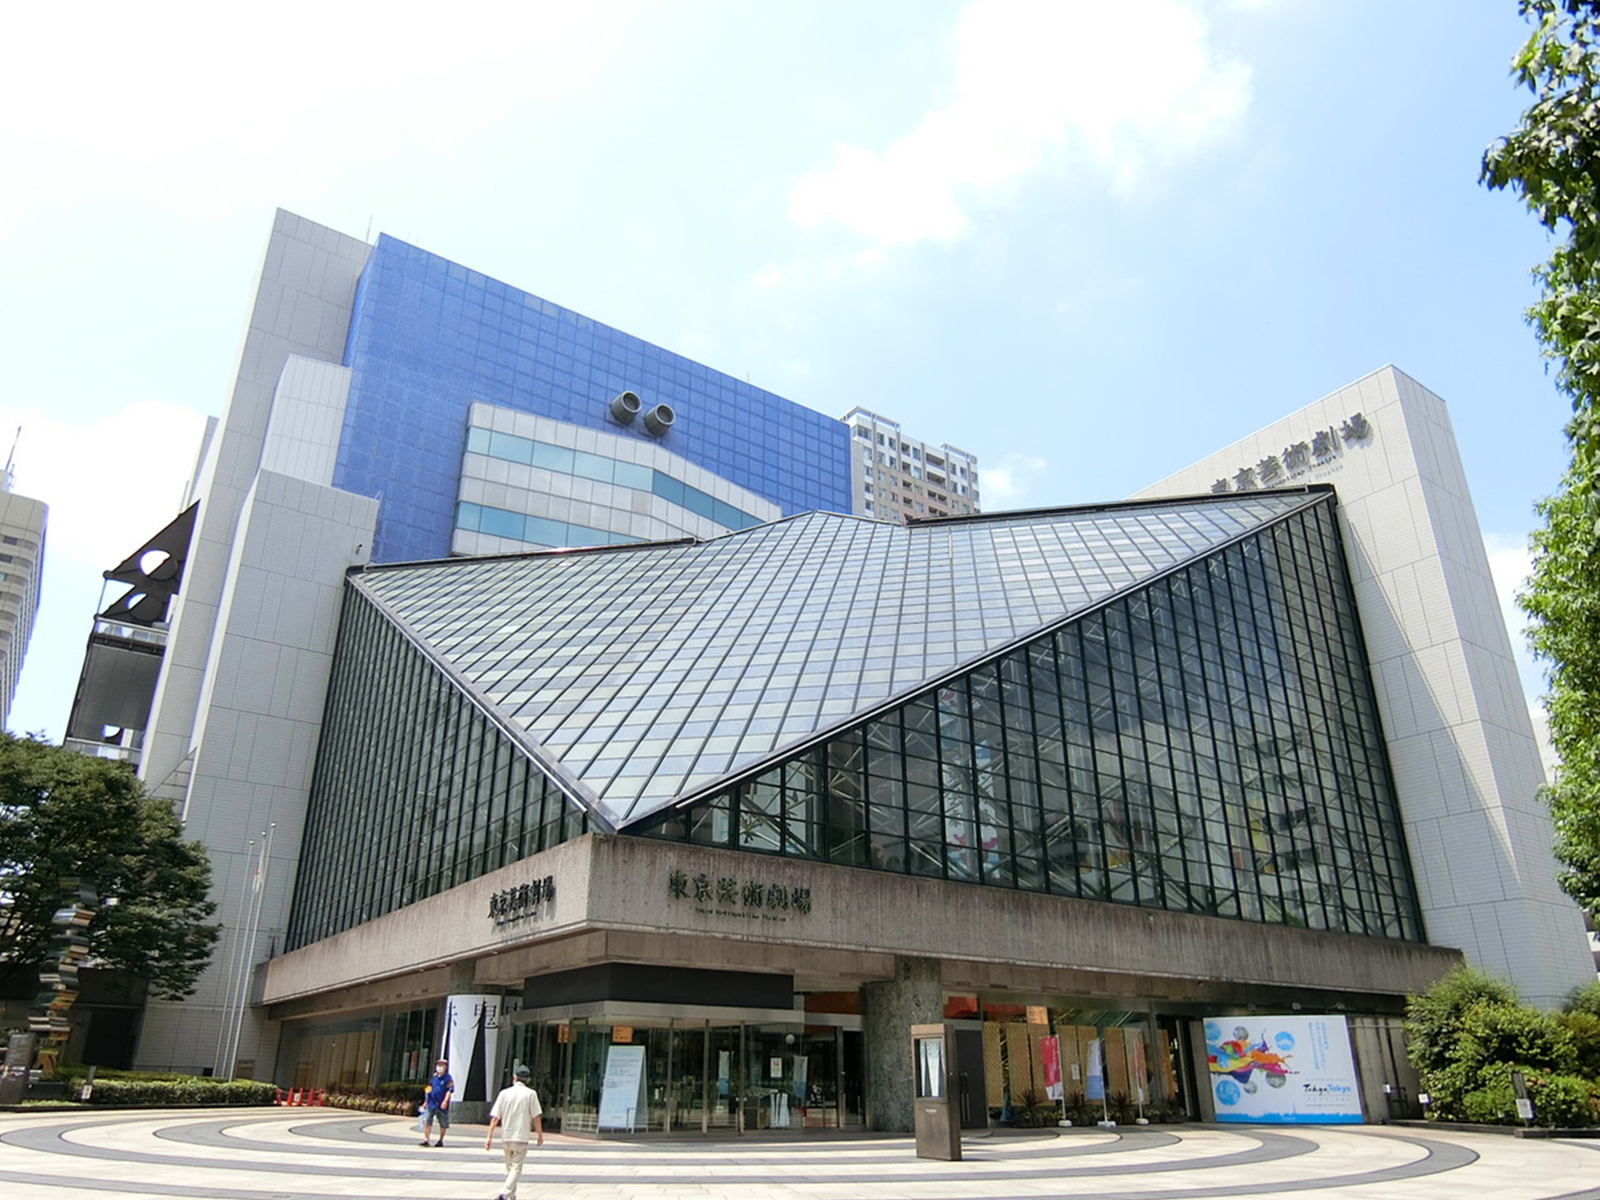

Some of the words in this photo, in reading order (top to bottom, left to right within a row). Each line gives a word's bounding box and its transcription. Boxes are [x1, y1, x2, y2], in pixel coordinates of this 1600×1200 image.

[668, 870, 812, 915] 東京芸術劇場
